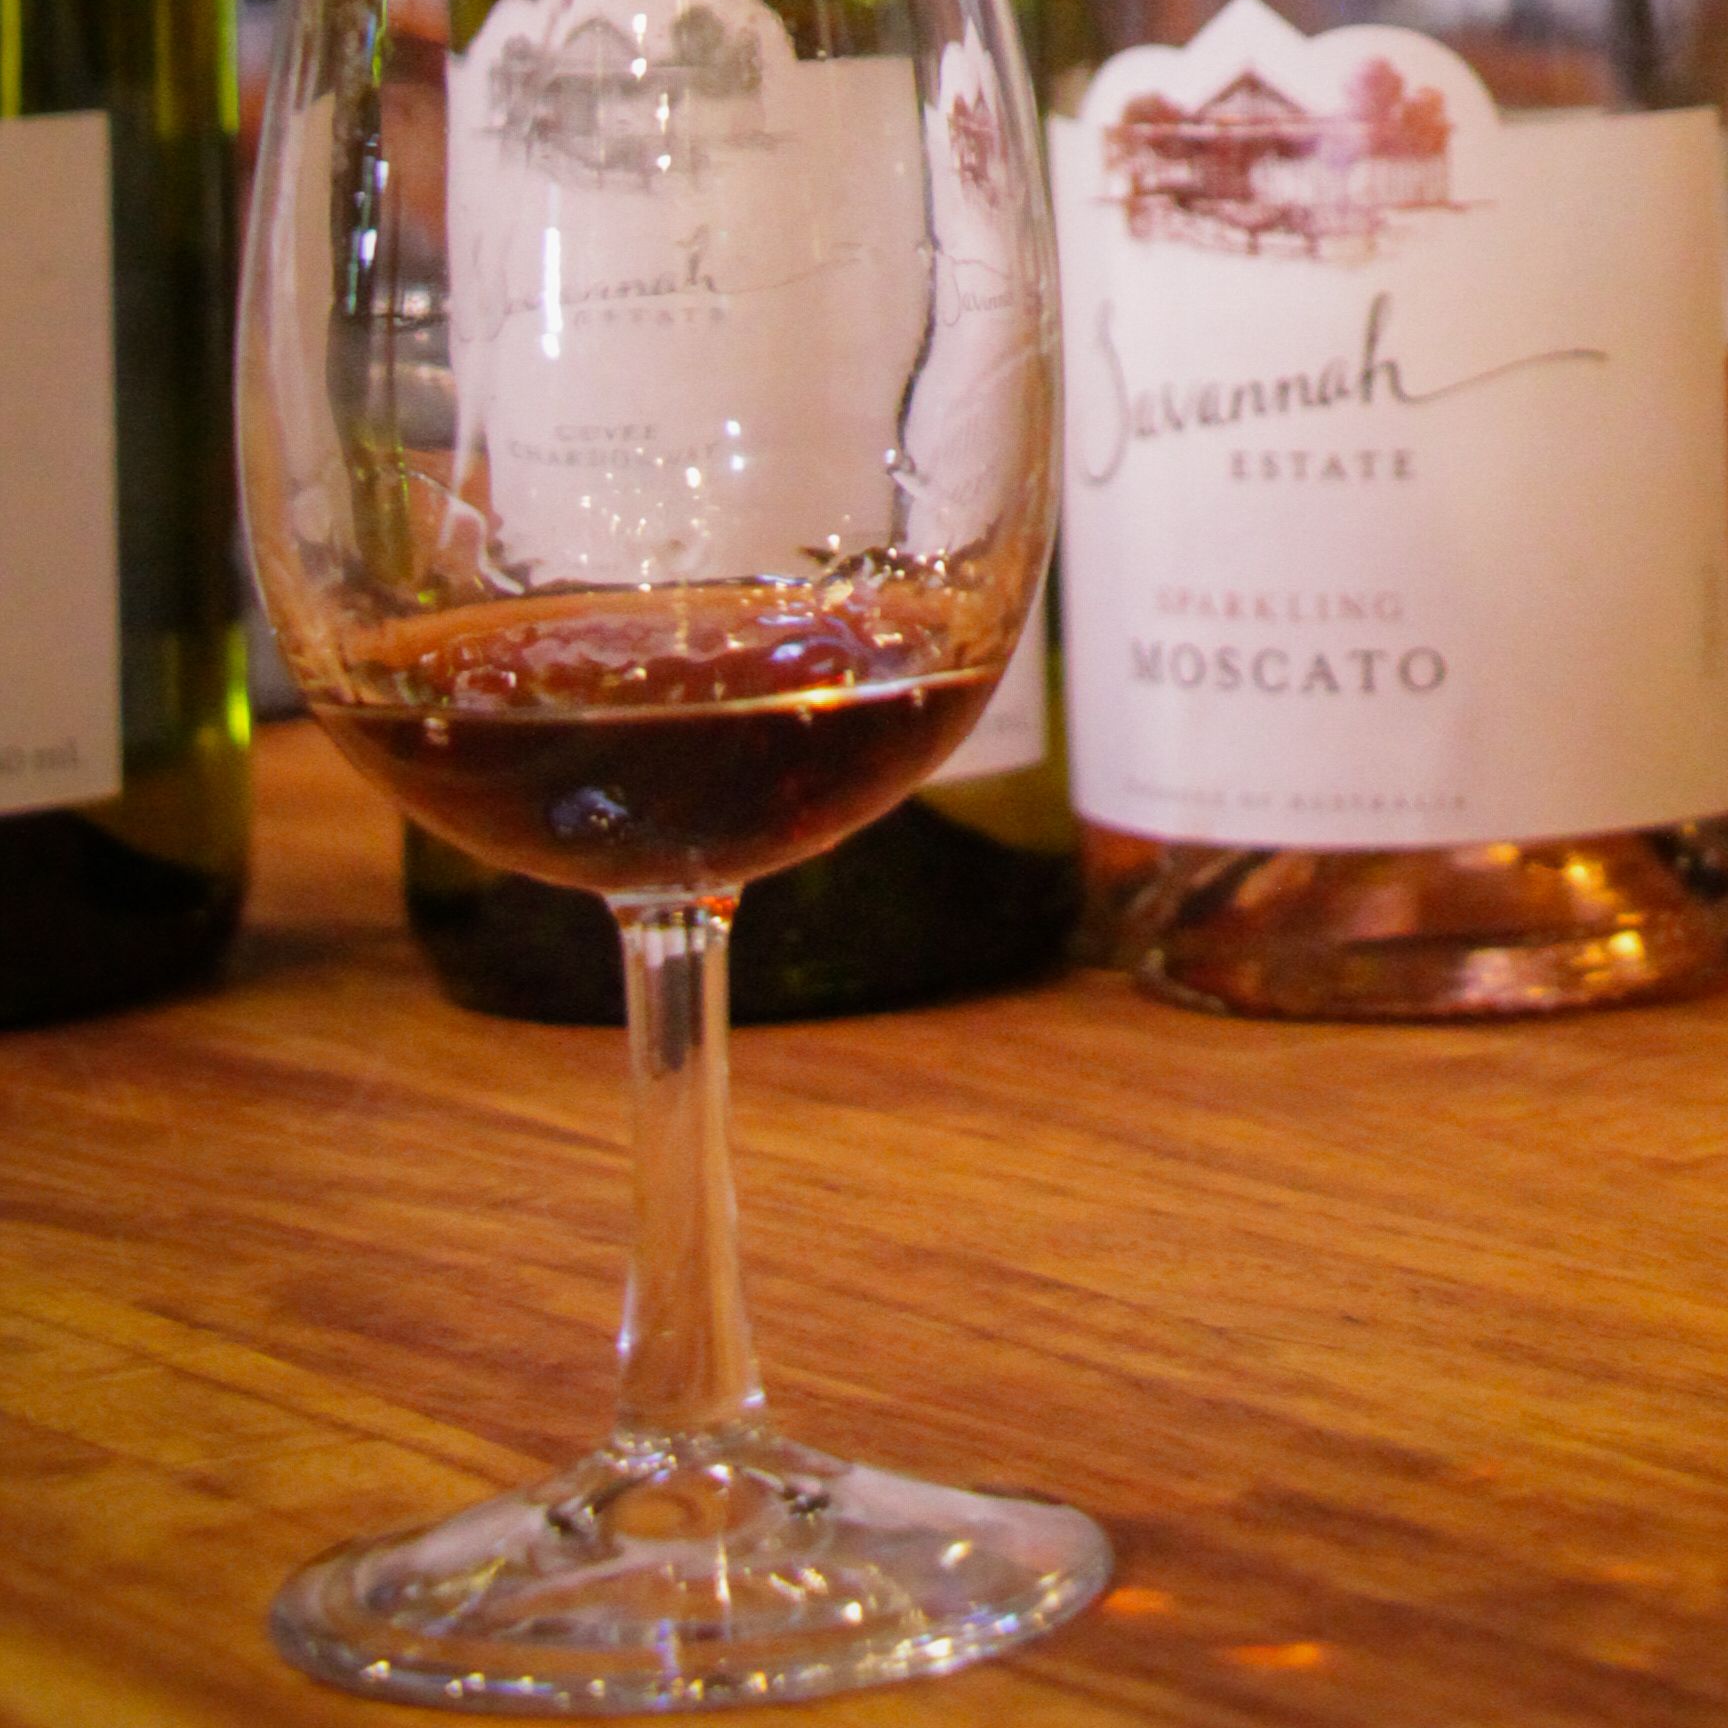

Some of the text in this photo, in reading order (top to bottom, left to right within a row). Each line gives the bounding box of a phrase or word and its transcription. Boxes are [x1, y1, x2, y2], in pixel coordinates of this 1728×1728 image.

[1078, 292, 1609, 487] Savannah
[1229, 447, 1418, 482] ESTATE
[1155, 585, 1404, 623] SPARKLING
[1131, 636, 1448, 696] MOSCATO
